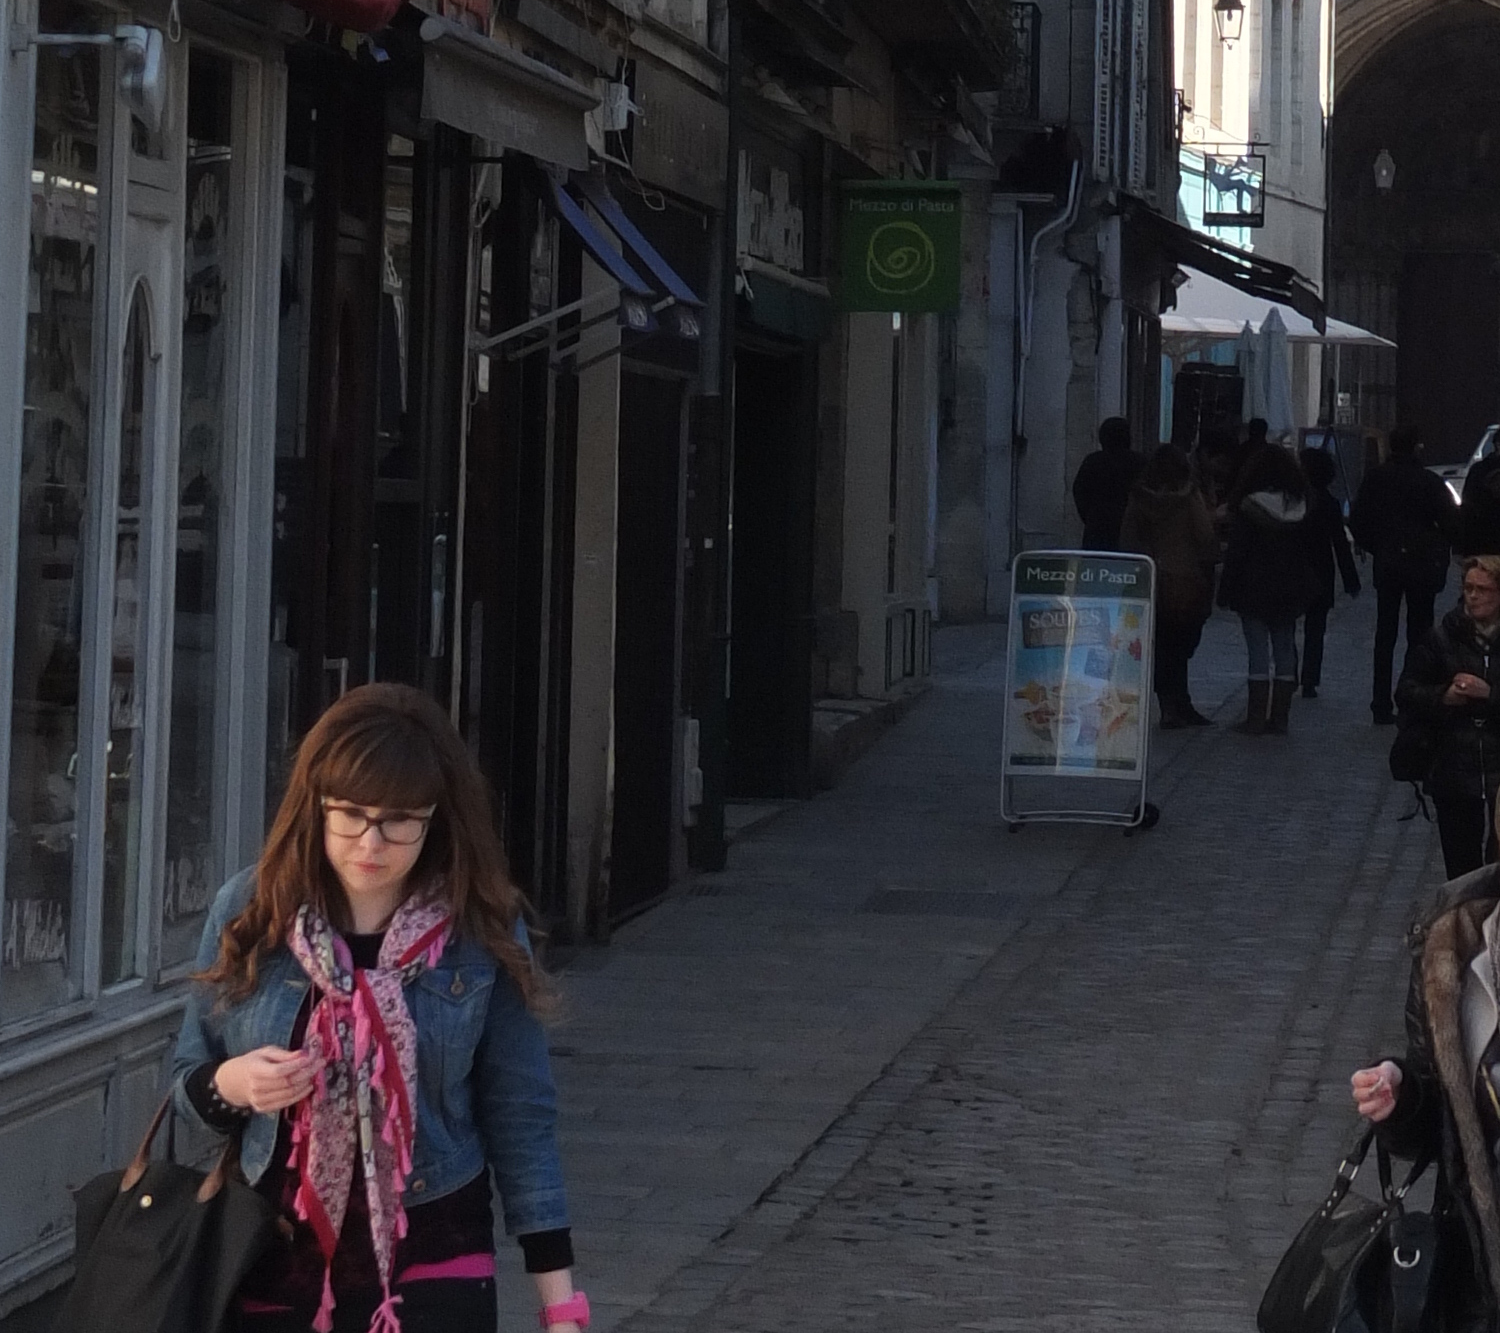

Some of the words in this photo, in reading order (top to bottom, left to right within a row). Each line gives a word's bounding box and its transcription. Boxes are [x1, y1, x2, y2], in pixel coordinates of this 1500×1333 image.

[849, 198, 897, 212] Mezzo
[901, 198, 914, 212] di
[919, 198, 955, 212] Pasta
[1027, 567, 1076, 582] Mezzo
[1080, 567, 1094, 582] di
[1099, 568, 1137, 584] Pasta
[1029, 611, 1101, 630] SOUES
